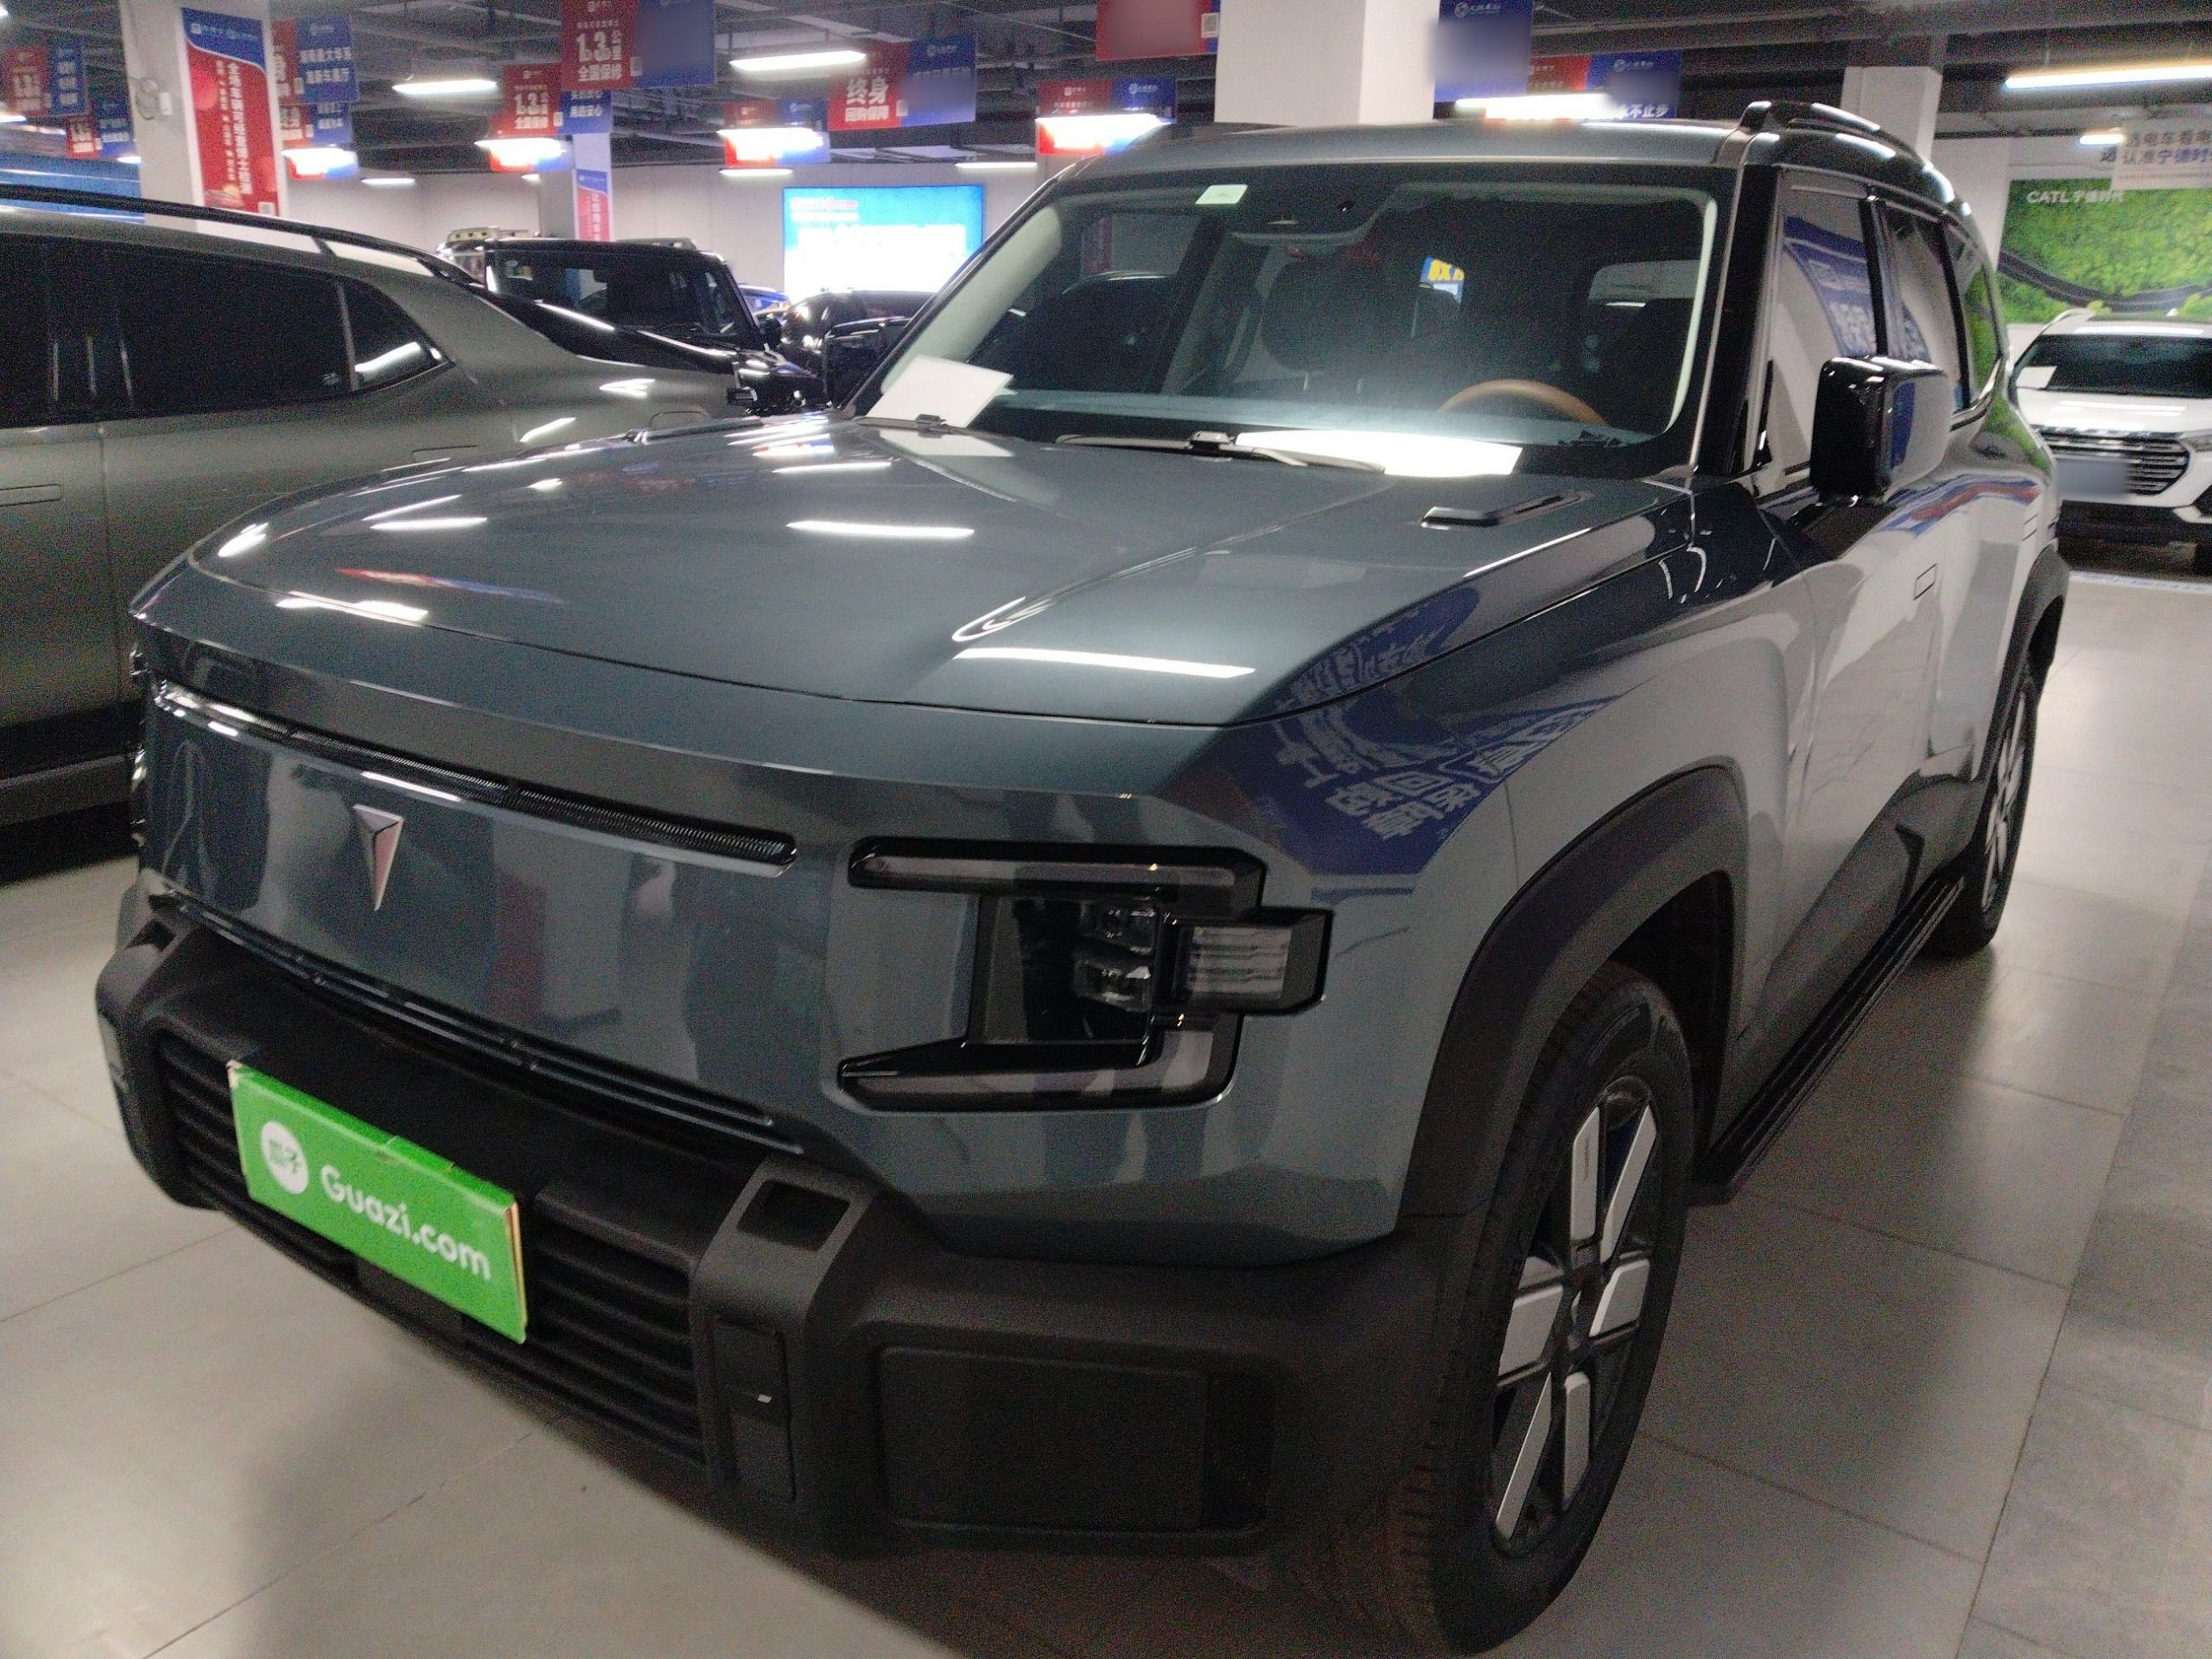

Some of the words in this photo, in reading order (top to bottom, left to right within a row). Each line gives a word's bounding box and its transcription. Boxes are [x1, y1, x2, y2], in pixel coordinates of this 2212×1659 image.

[846, 76, 889, 104] 终身
[2027, 191, 2069, 203] CATL
[321, 1165, 491, 1281] Guazi.com
